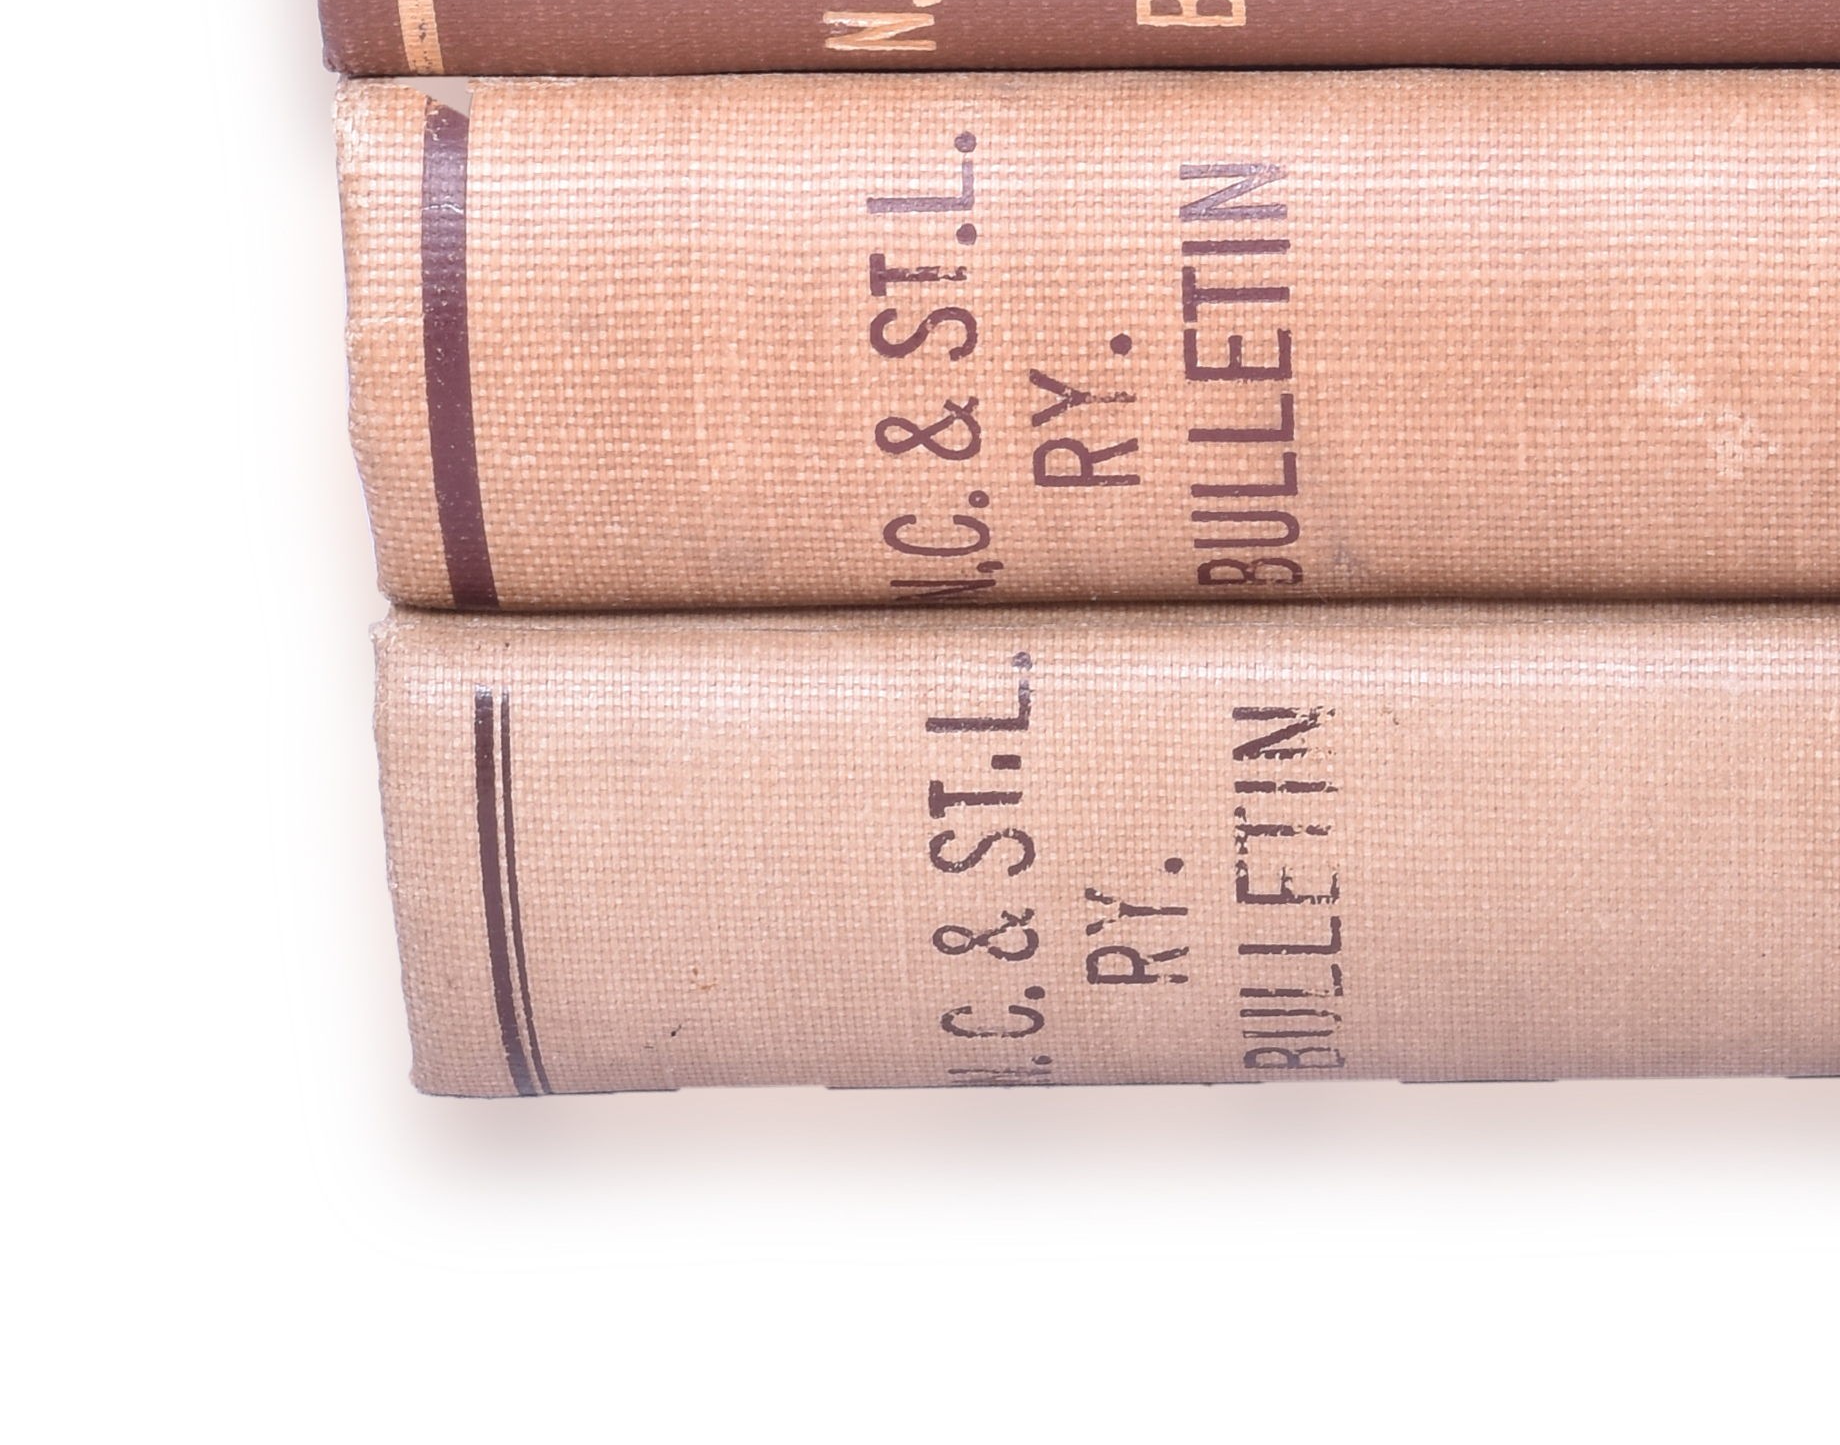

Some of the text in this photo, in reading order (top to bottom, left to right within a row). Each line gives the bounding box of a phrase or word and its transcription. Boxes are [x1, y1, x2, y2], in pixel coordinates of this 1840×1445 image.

[866, 131, 978, 361] ST.L.
[875, 396, 981, 460] &
[1029, 333, 1140, 487] RY.
[1178, 163, 1303, 585] BULLETIN
[932, 908, 1039, 962] &
[1085, 857, 1189, 984] RY.
[1232, 706, 1345, 1068] BULLETIN
